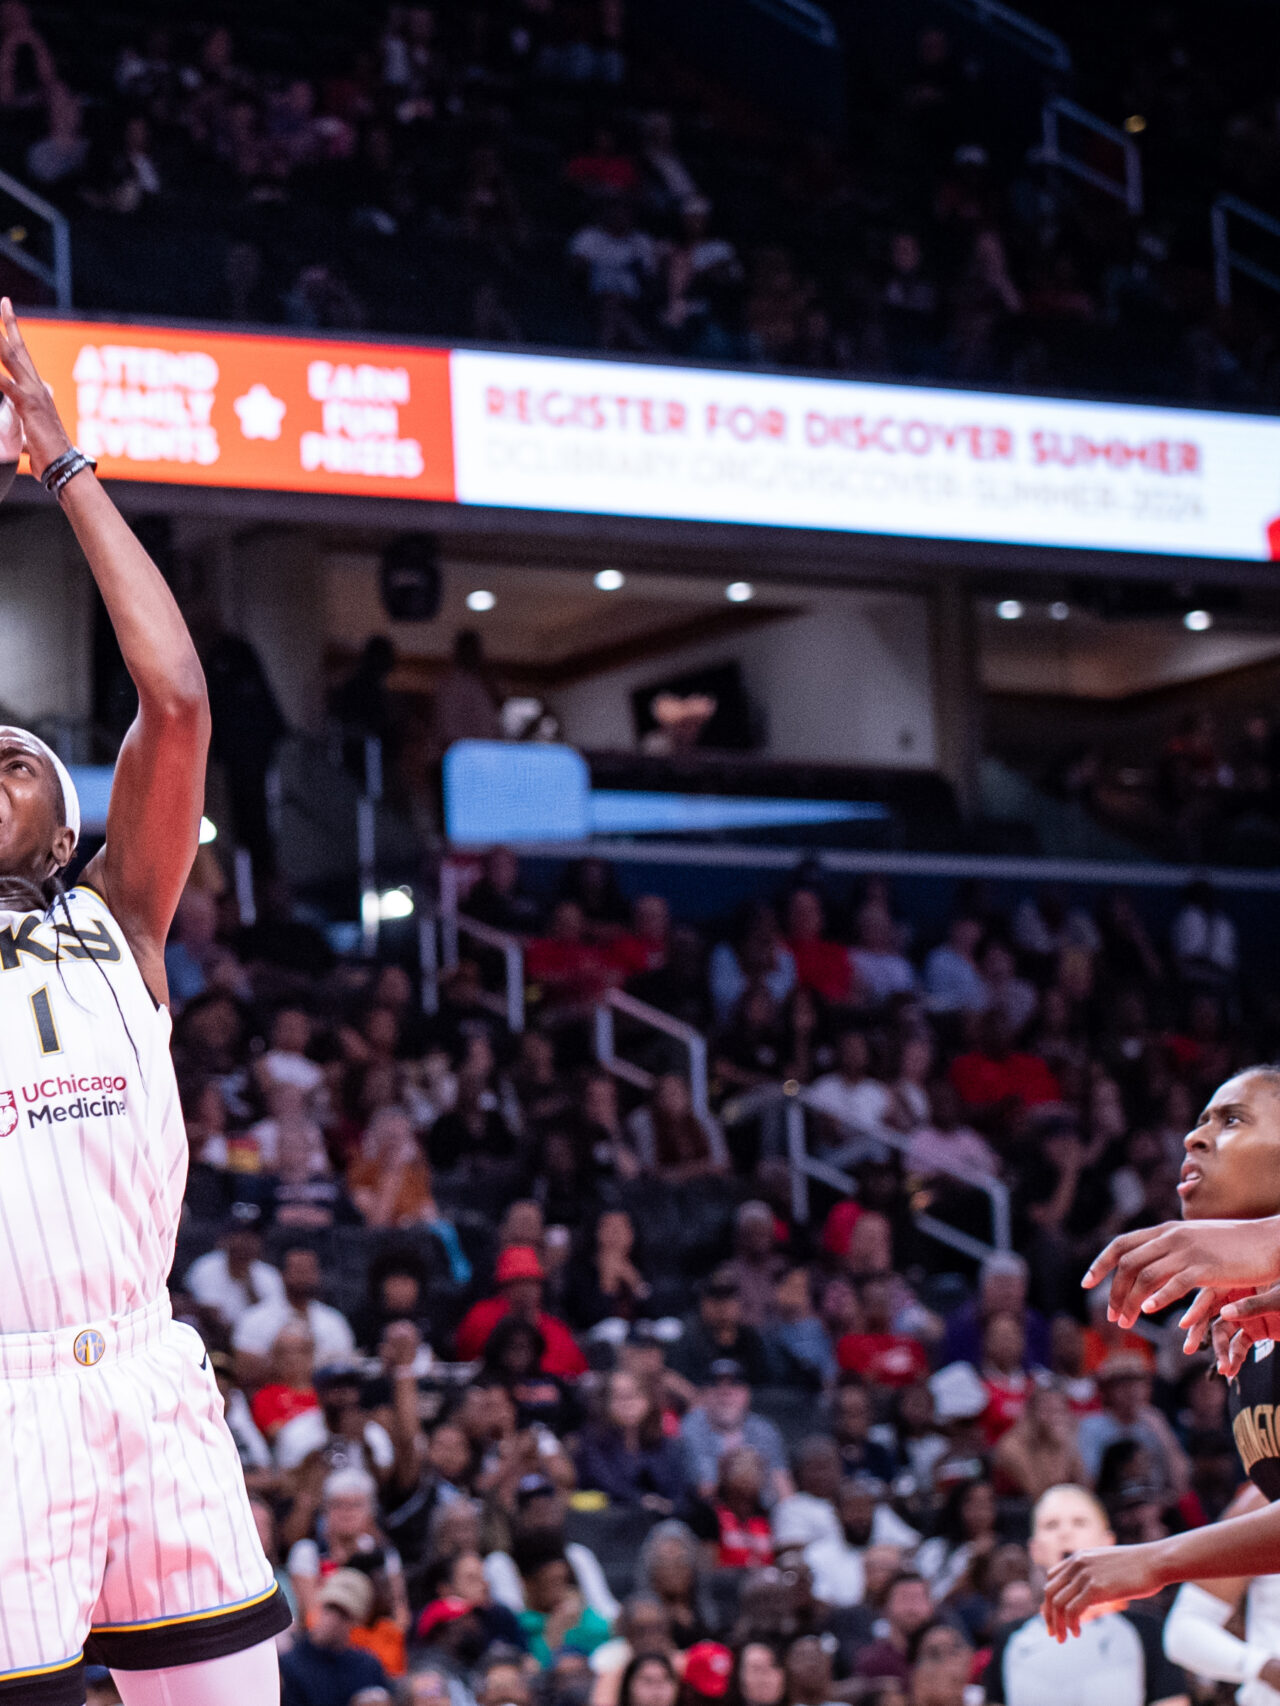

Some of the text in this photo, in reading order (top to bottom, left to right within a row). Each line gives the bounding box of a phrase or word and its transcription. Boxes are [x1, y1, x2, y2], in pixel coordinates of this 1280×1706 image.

[72, 344, 220, 391] ATTEND
[308, 360, 410, 405] EARN
[77, 382, 215, 426] FAMILY
[323, 400, 399, 439] FUN
[77, 417, 220, 465] EVENTS
[484, 385, 1203, 476] REGISTER FOR DISCOVER SUMMER
[300, 431, 425, 479] PRIZES
[29, 983, 63, 1055] 1
[22, 1074, 127, 1103] UChicago
